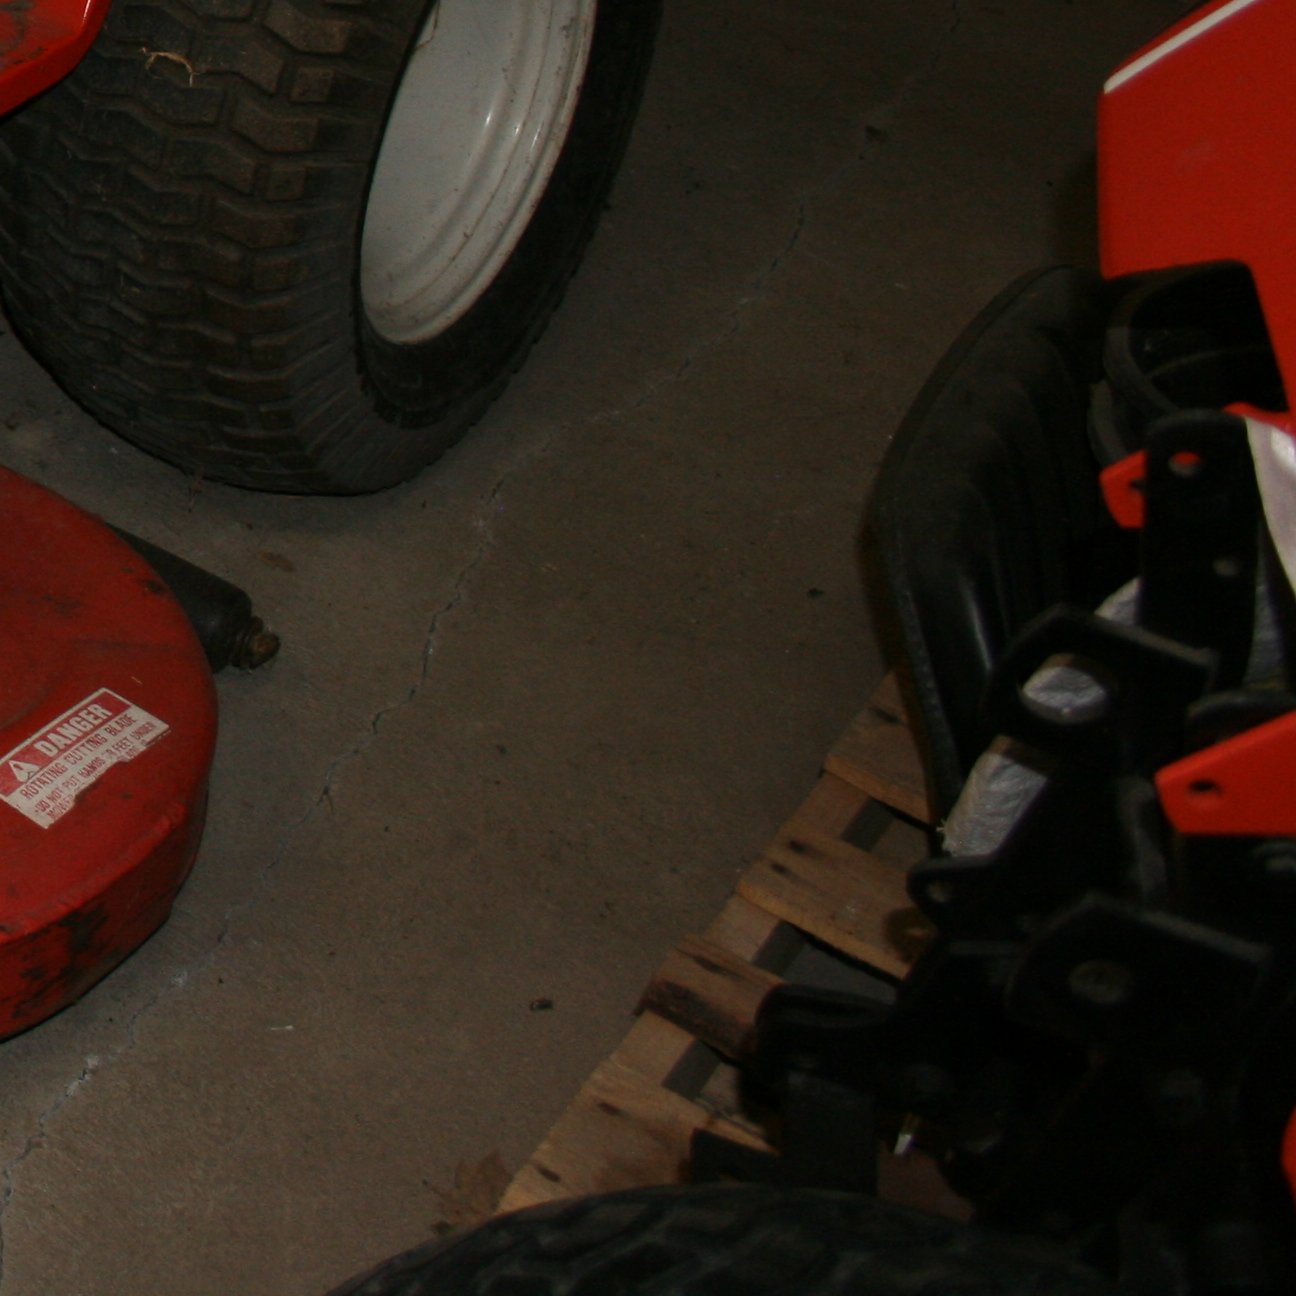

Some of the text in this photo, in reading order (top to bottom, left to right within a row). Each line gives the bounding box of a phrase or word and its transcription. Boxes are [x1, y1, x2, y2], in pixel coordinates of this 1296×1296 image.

[19, 761, 68, 801] ROTATING
[64, 732, 108, 771] CUTTING
[104, 713, 139, 738] BLADE
[34, 703, 113, 757] DANGER
[79, 756, 106, 779] HANDS
[113, 736, 135, 755] FEET
[130, 721, 157, 741] UNDER
